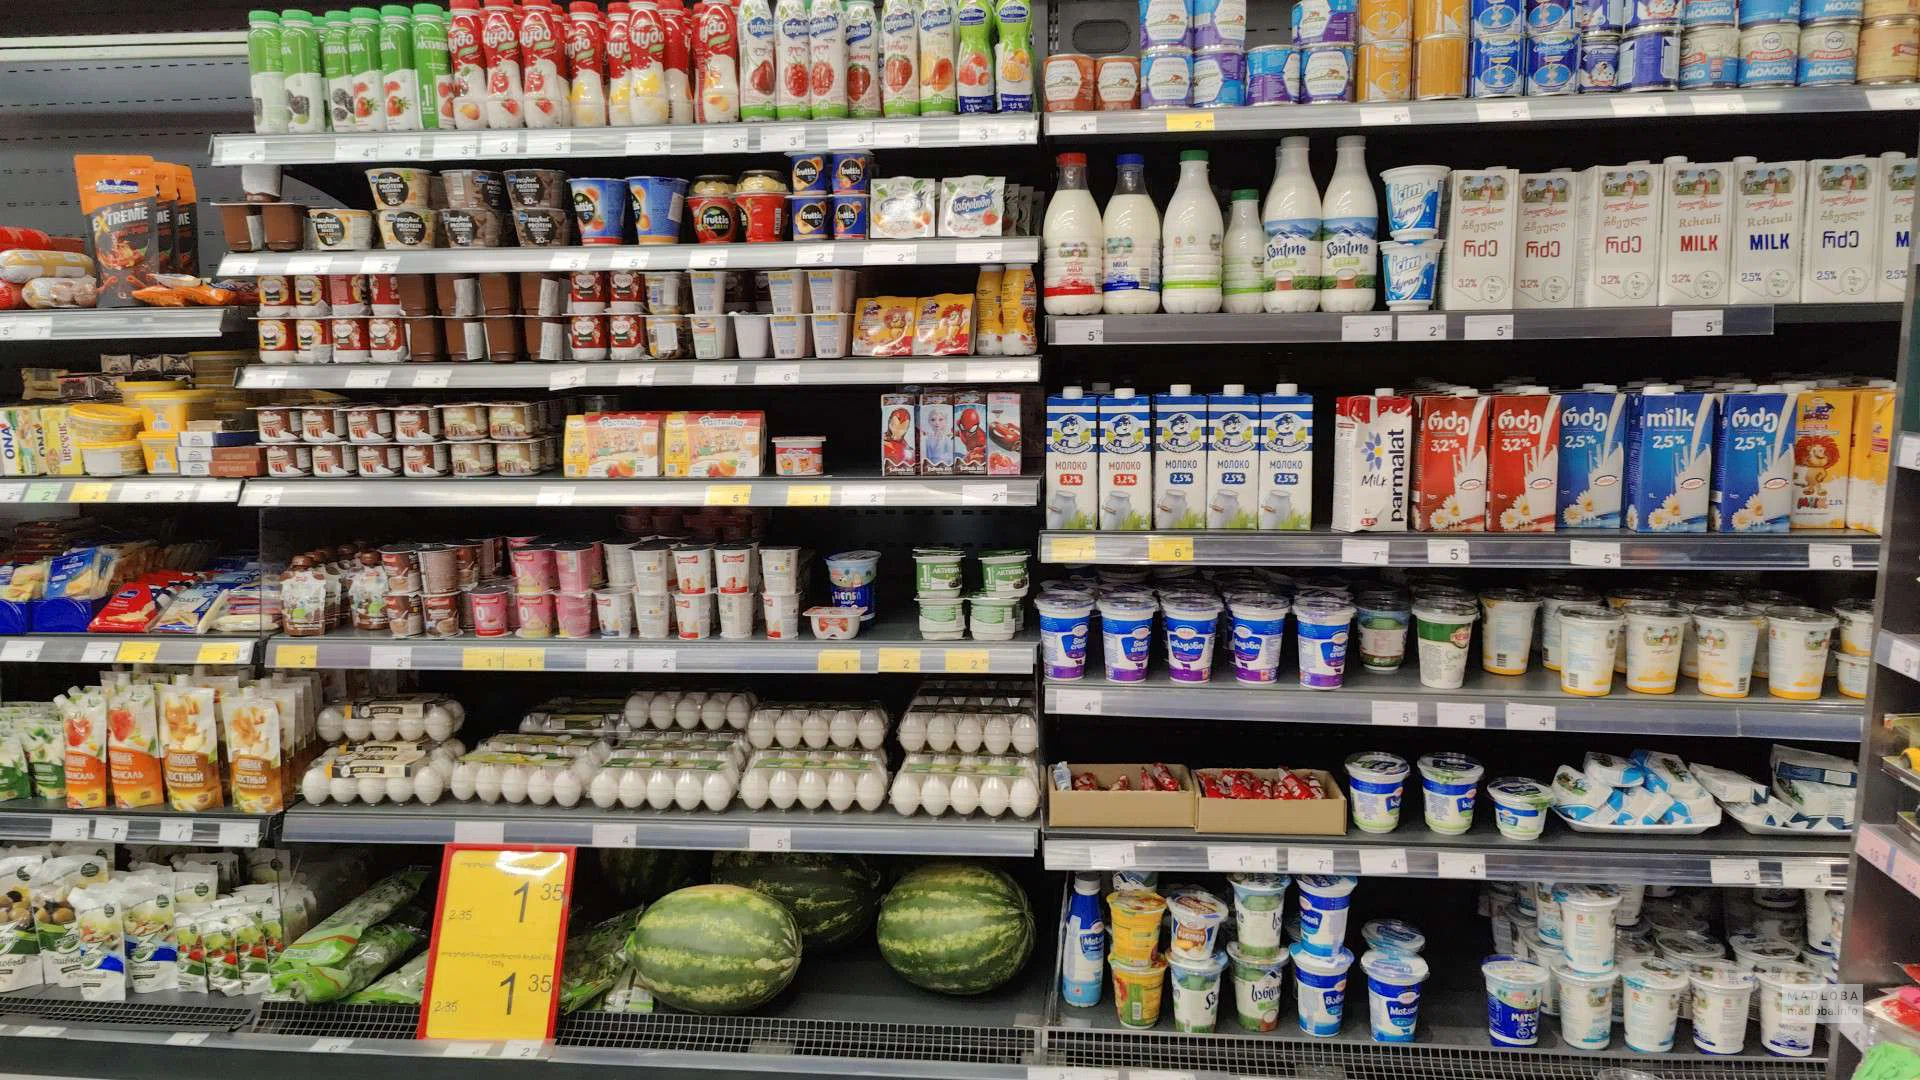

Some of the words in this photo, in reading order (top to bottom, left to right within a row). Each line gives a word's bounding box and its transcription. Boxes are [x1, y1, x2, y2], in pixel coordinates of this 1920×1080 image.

[1746, 66, 1792, 79] МОЛОКО
[93, 206, 149, 233] EXTREME
[703, 214, 729, 226] fruttis
[1679, 213, 1721, 229] Rcheuli
[1747, 213, 1793, 229] Rcheuli
[1463, 239, 1498, 258] რძე
[1526, 240, 1560, 258] რძე
[1605, 236, 1642, 254] რძე
[1680, 235, 1719, 252] MILK
[1750, 233, 1790, 251] MILK
[1823, 230, 1860, 250] რძე
[1088, 331, 1095, 341] 5
[1428, 409, 1469, 434] რძე
[1497, 409, 1543, 435] რძე
[1562, 409, 1607, 434] რძე
[1646, 407, 1695, 429] milk
[1732, 408, 1778, 433] რძე
[2, 426, 16, 460] ONA
[1055, 461, 1088, 471] МОЛОКО
[1108, 461, 1141, 471] МОЛОКО
[1165, 459, 1198, 470] МОЛОКО
[1217, 459, 1250, 470] МОЛОКО
[1269, 460, 1303, 470] МОЛОКО
[1389, 428, 1405, 523] parmalat
[514, 880, 530, 923] 1
[540, 882, 564, 902] 35
[500, 972, 516, 1016] 1
[528, 973, 552, 993] 35
